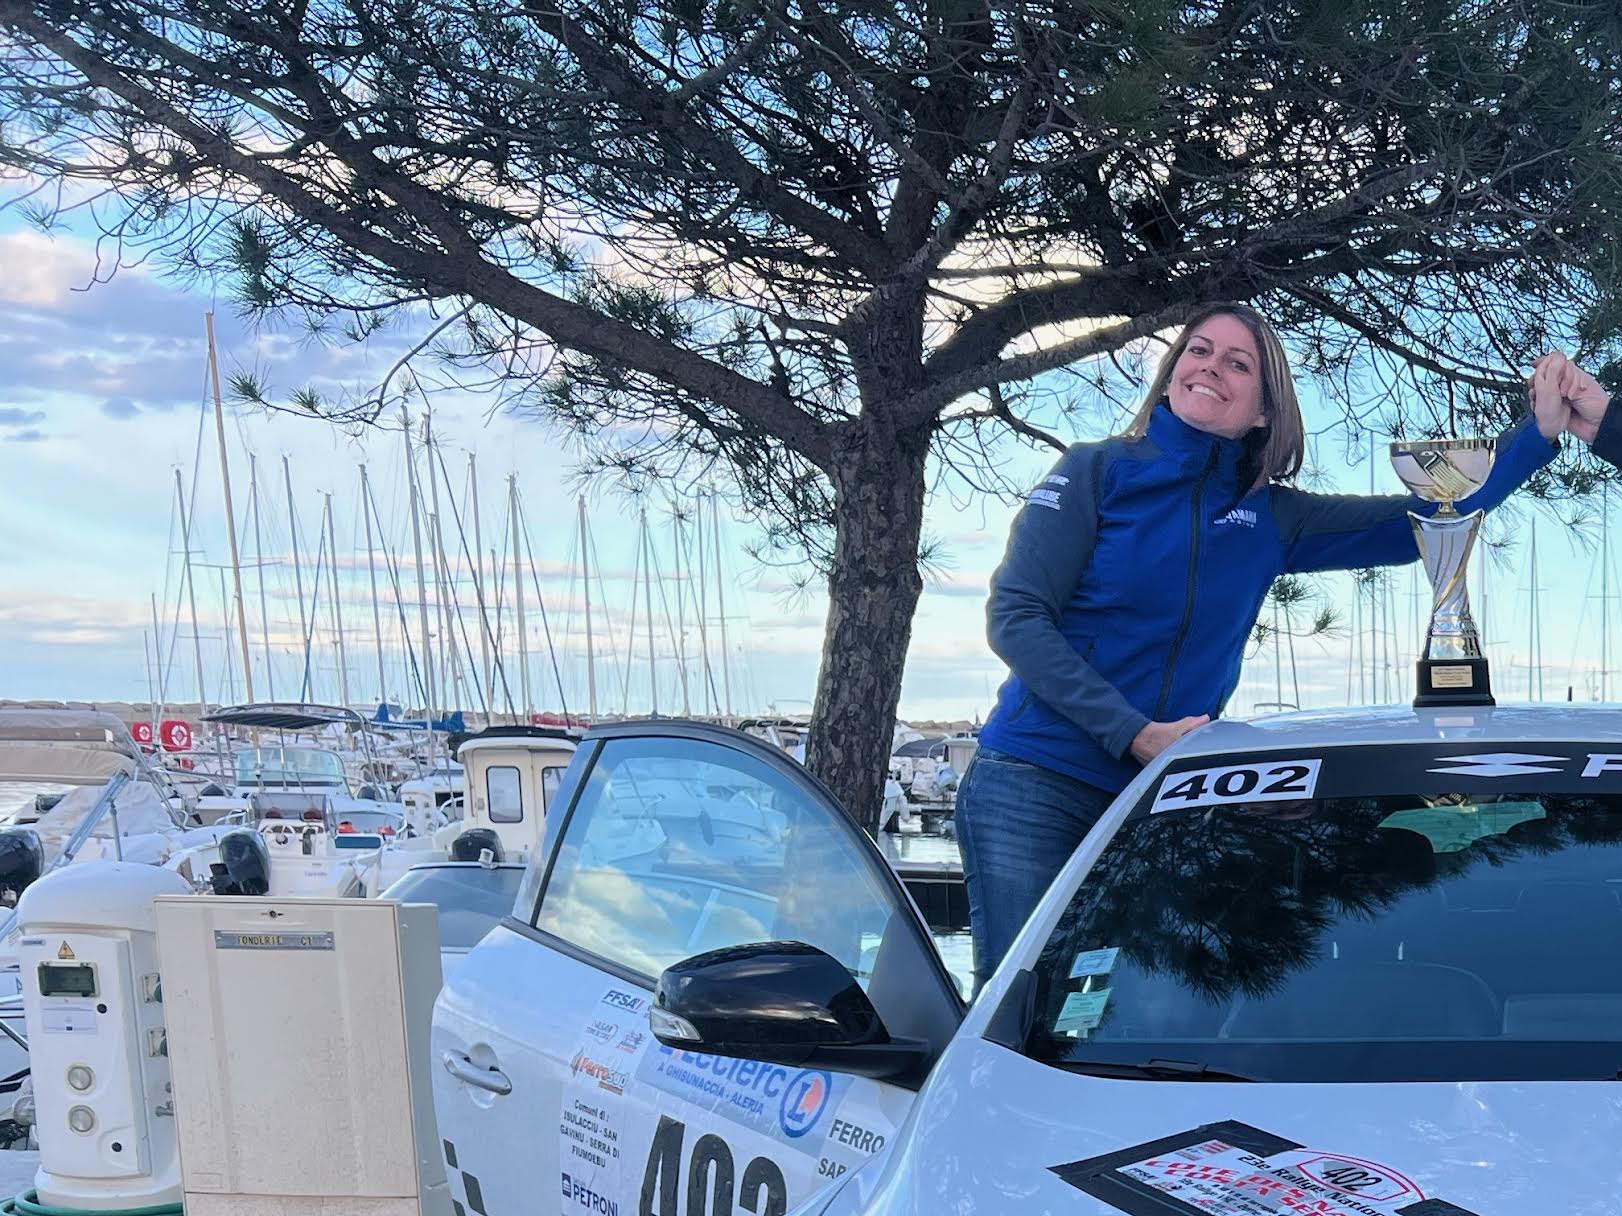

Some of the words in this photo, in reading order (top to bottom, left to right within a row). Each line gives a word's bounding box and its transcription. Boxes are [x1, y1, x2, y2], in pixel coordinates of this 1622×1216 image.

[1160, 765, 1310, 801] 402
[657, 1062, 665, 1073] A
[666, 1066, 725, 1099] GHISUNACCIA
[730, 1091, 764, 1116] ALERIA
[590, 1135, 611, 1156] SERRA
[612, 1148, 620, 1159] DI
[603, 1128, 618, 1142] SAN
[1238, 1155, 1272, 1170] 23e
[1271, 1168, 1327, 1194] Rallye
[1320, 1167, 1383, 1191] 402
